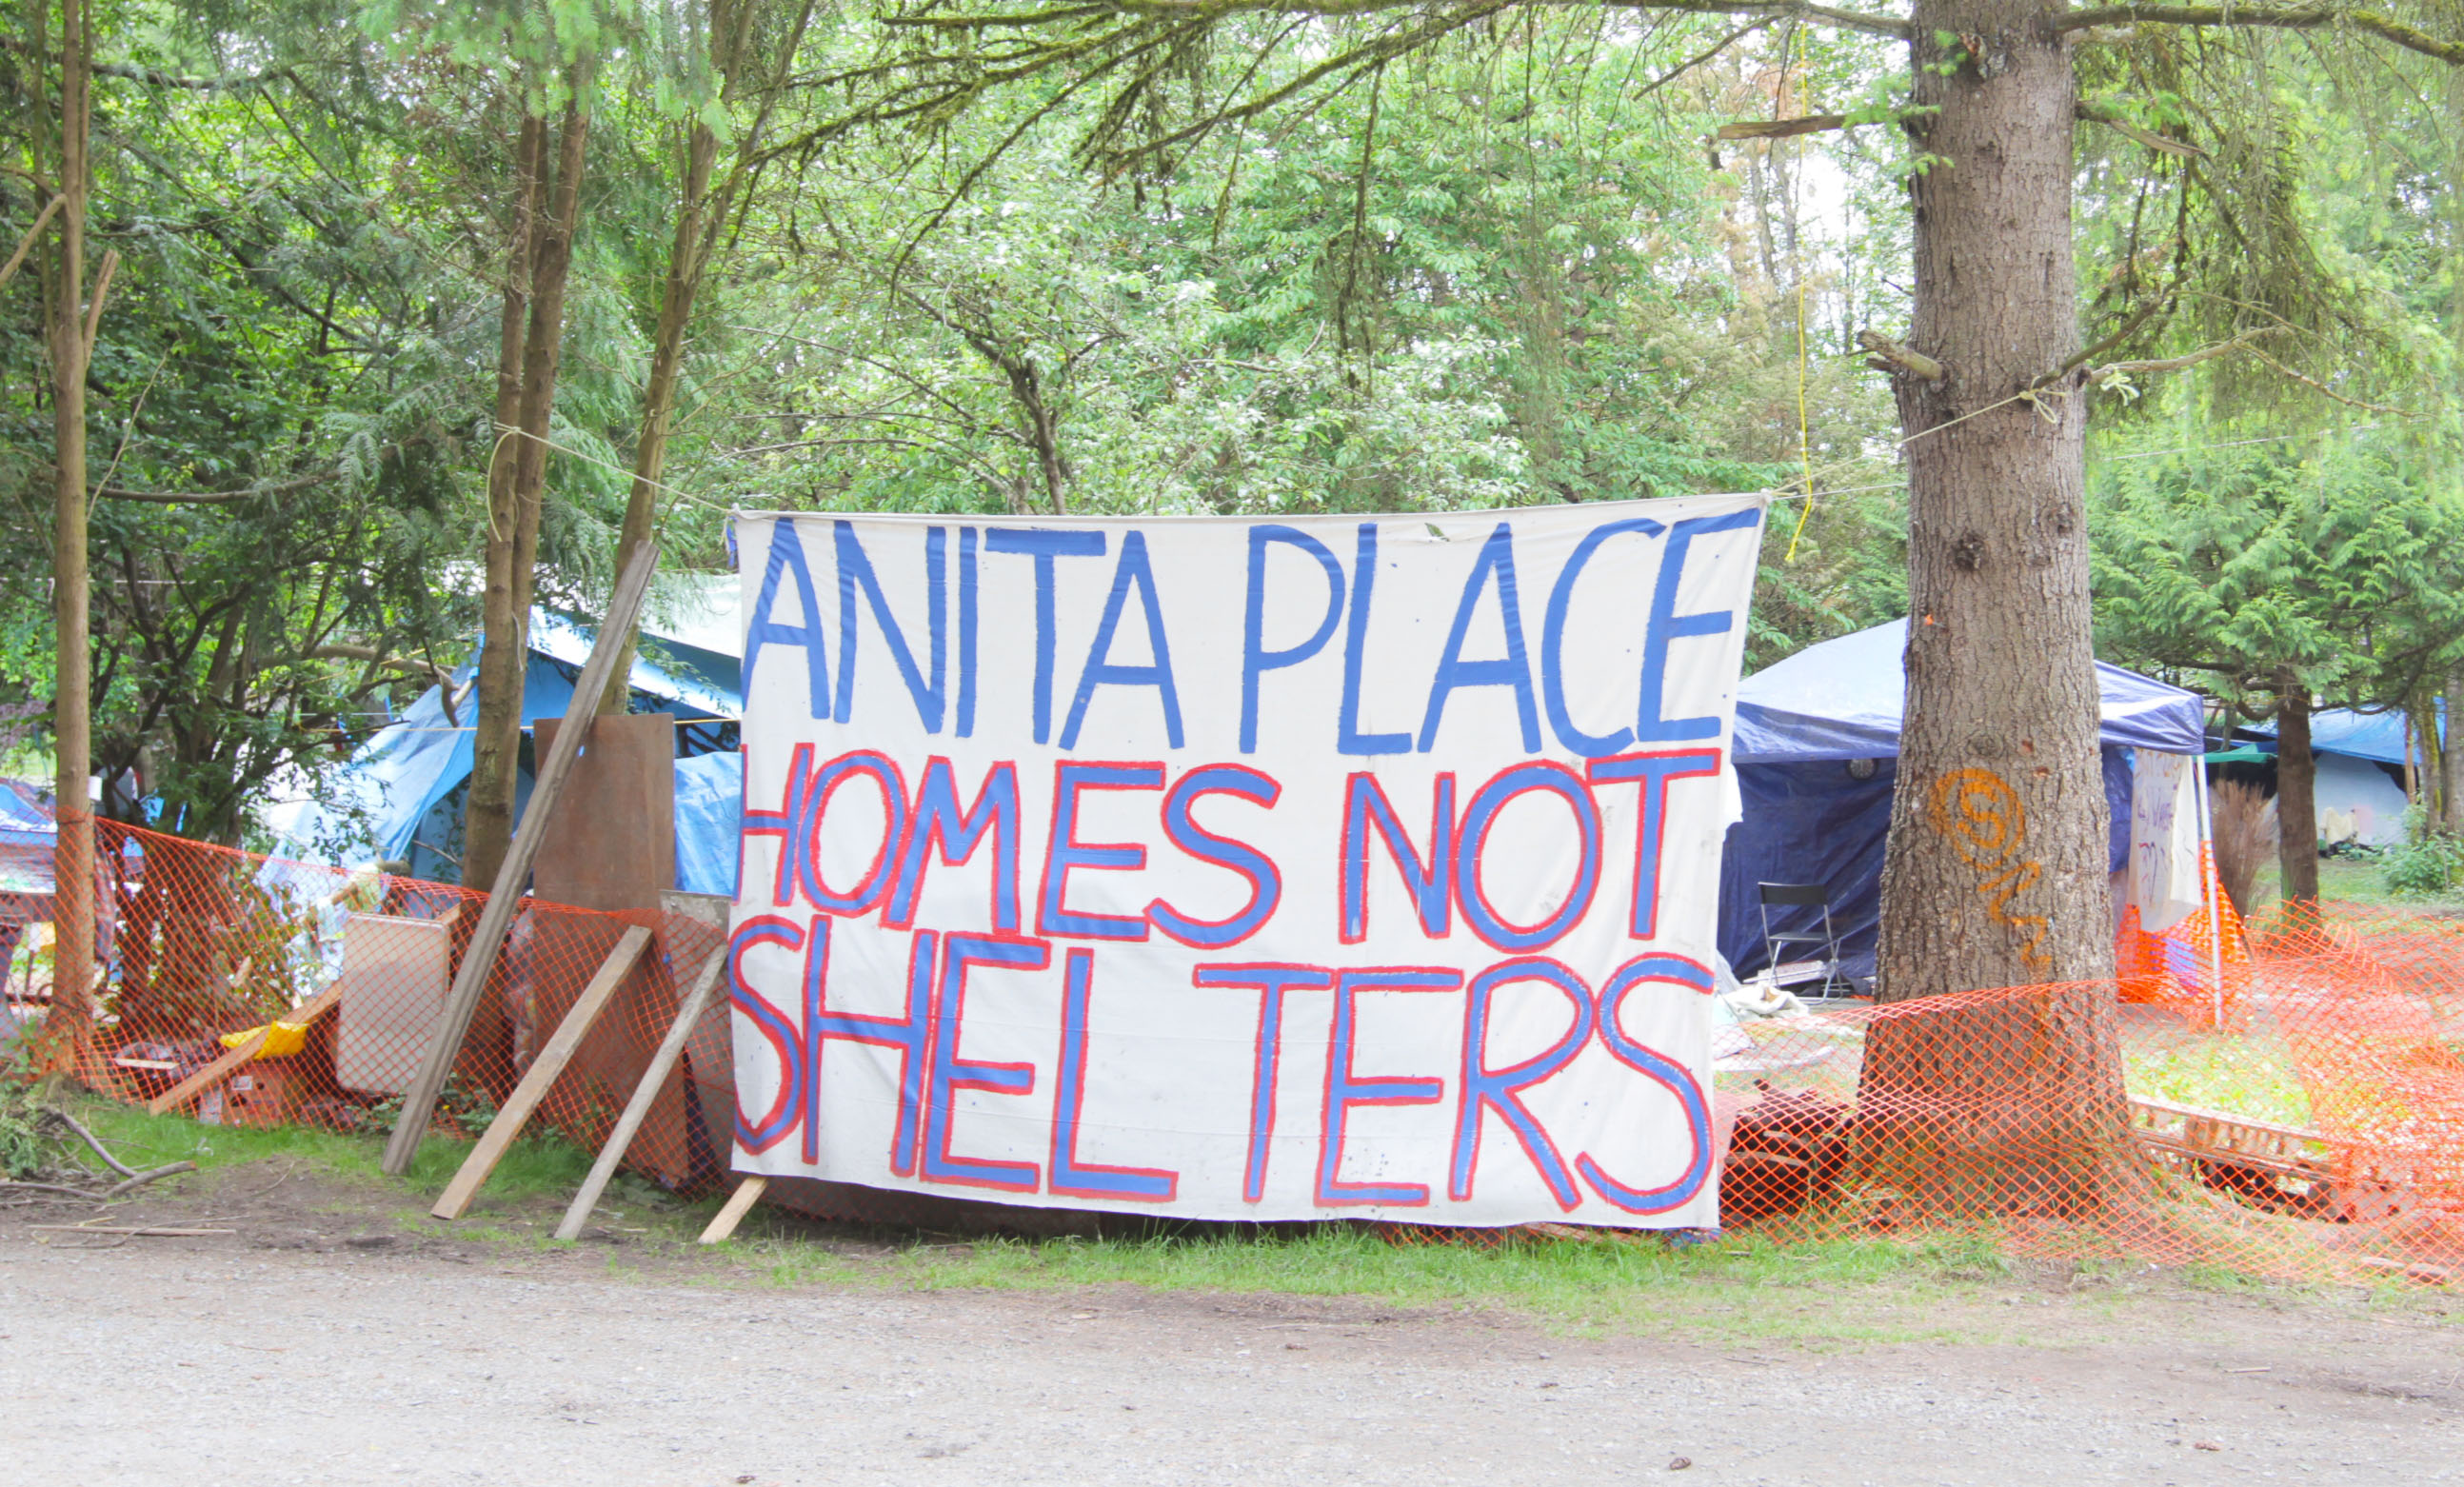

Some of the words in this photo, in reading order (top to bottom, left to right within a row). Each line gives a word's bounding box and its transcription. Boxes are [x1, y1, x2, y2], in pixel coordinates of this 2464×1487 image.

[741, 516, 1184, 751] ANITA
[1239, 507, 1759, 756] PLACE
[732, 742, 1282, 949] HOMES
[1339, 748, 1721, 952] NOT
[728, 914, 1714, 1216] SHELTERS
